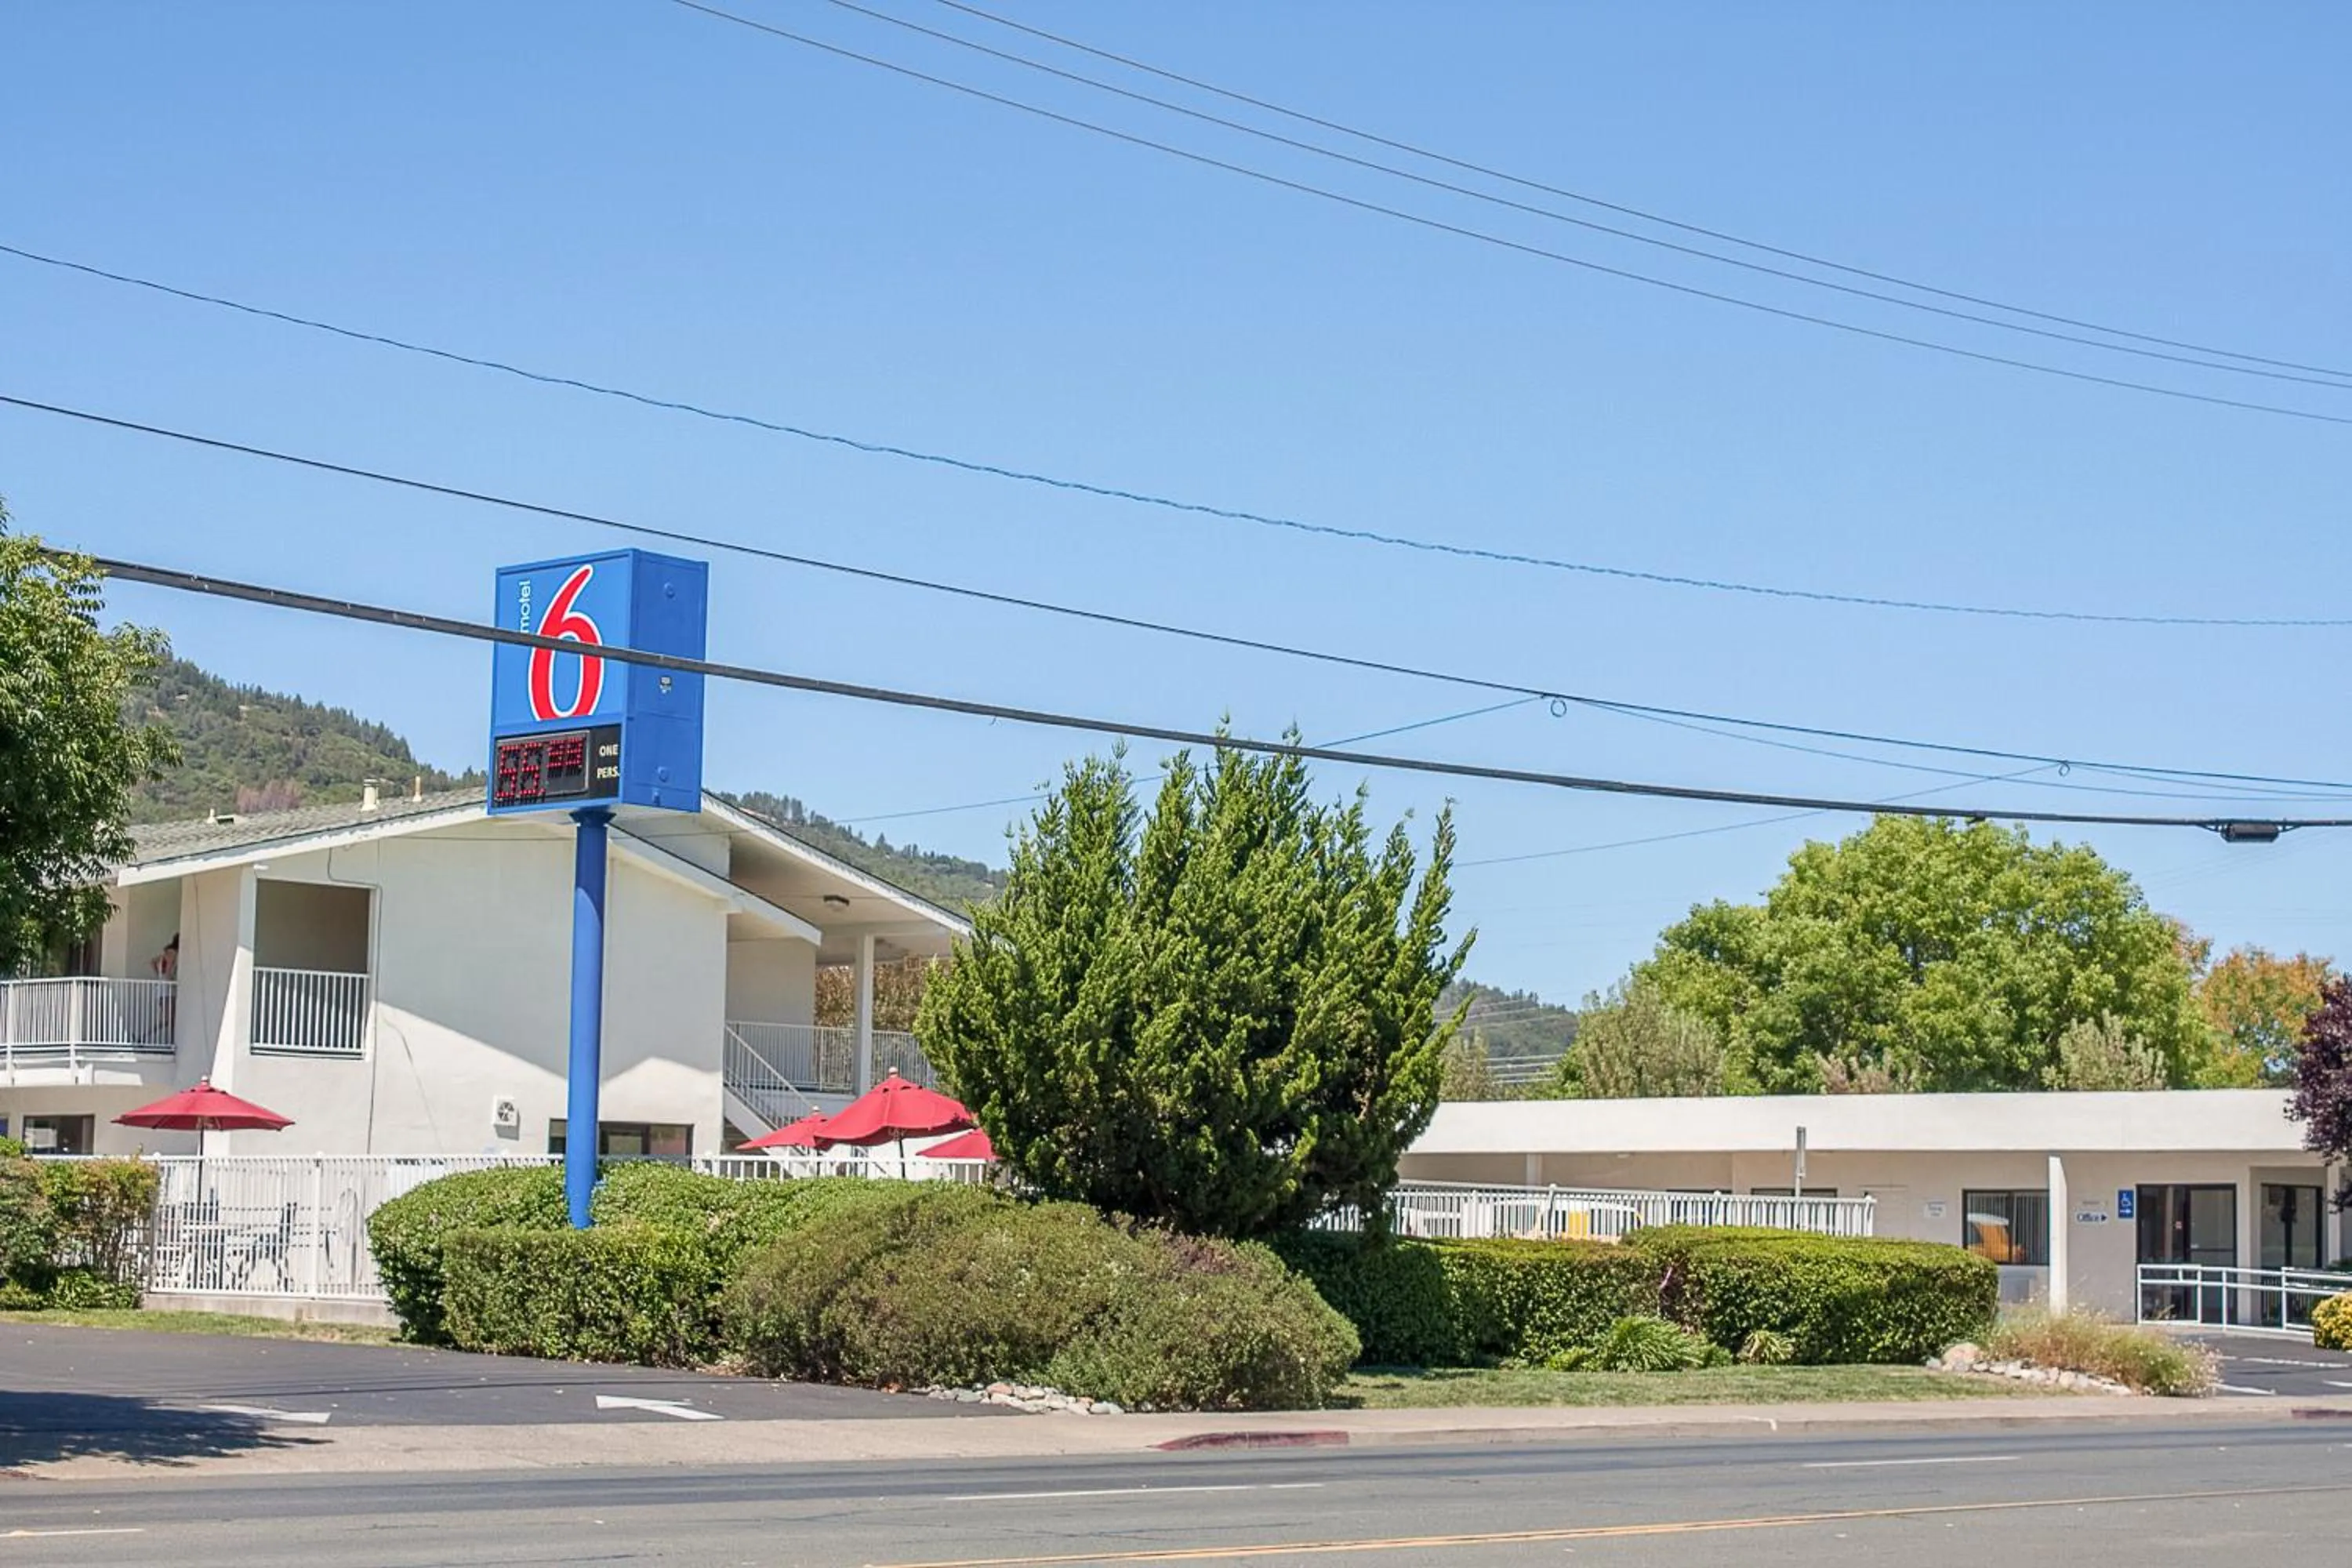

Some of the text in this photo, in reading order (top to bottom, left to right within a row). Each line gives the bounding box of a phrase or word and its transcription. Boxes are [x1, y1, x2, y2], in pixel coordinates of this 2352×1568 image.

[518, 564, 604, 721] motel 6
[598, 743, 619, 757] ONE
